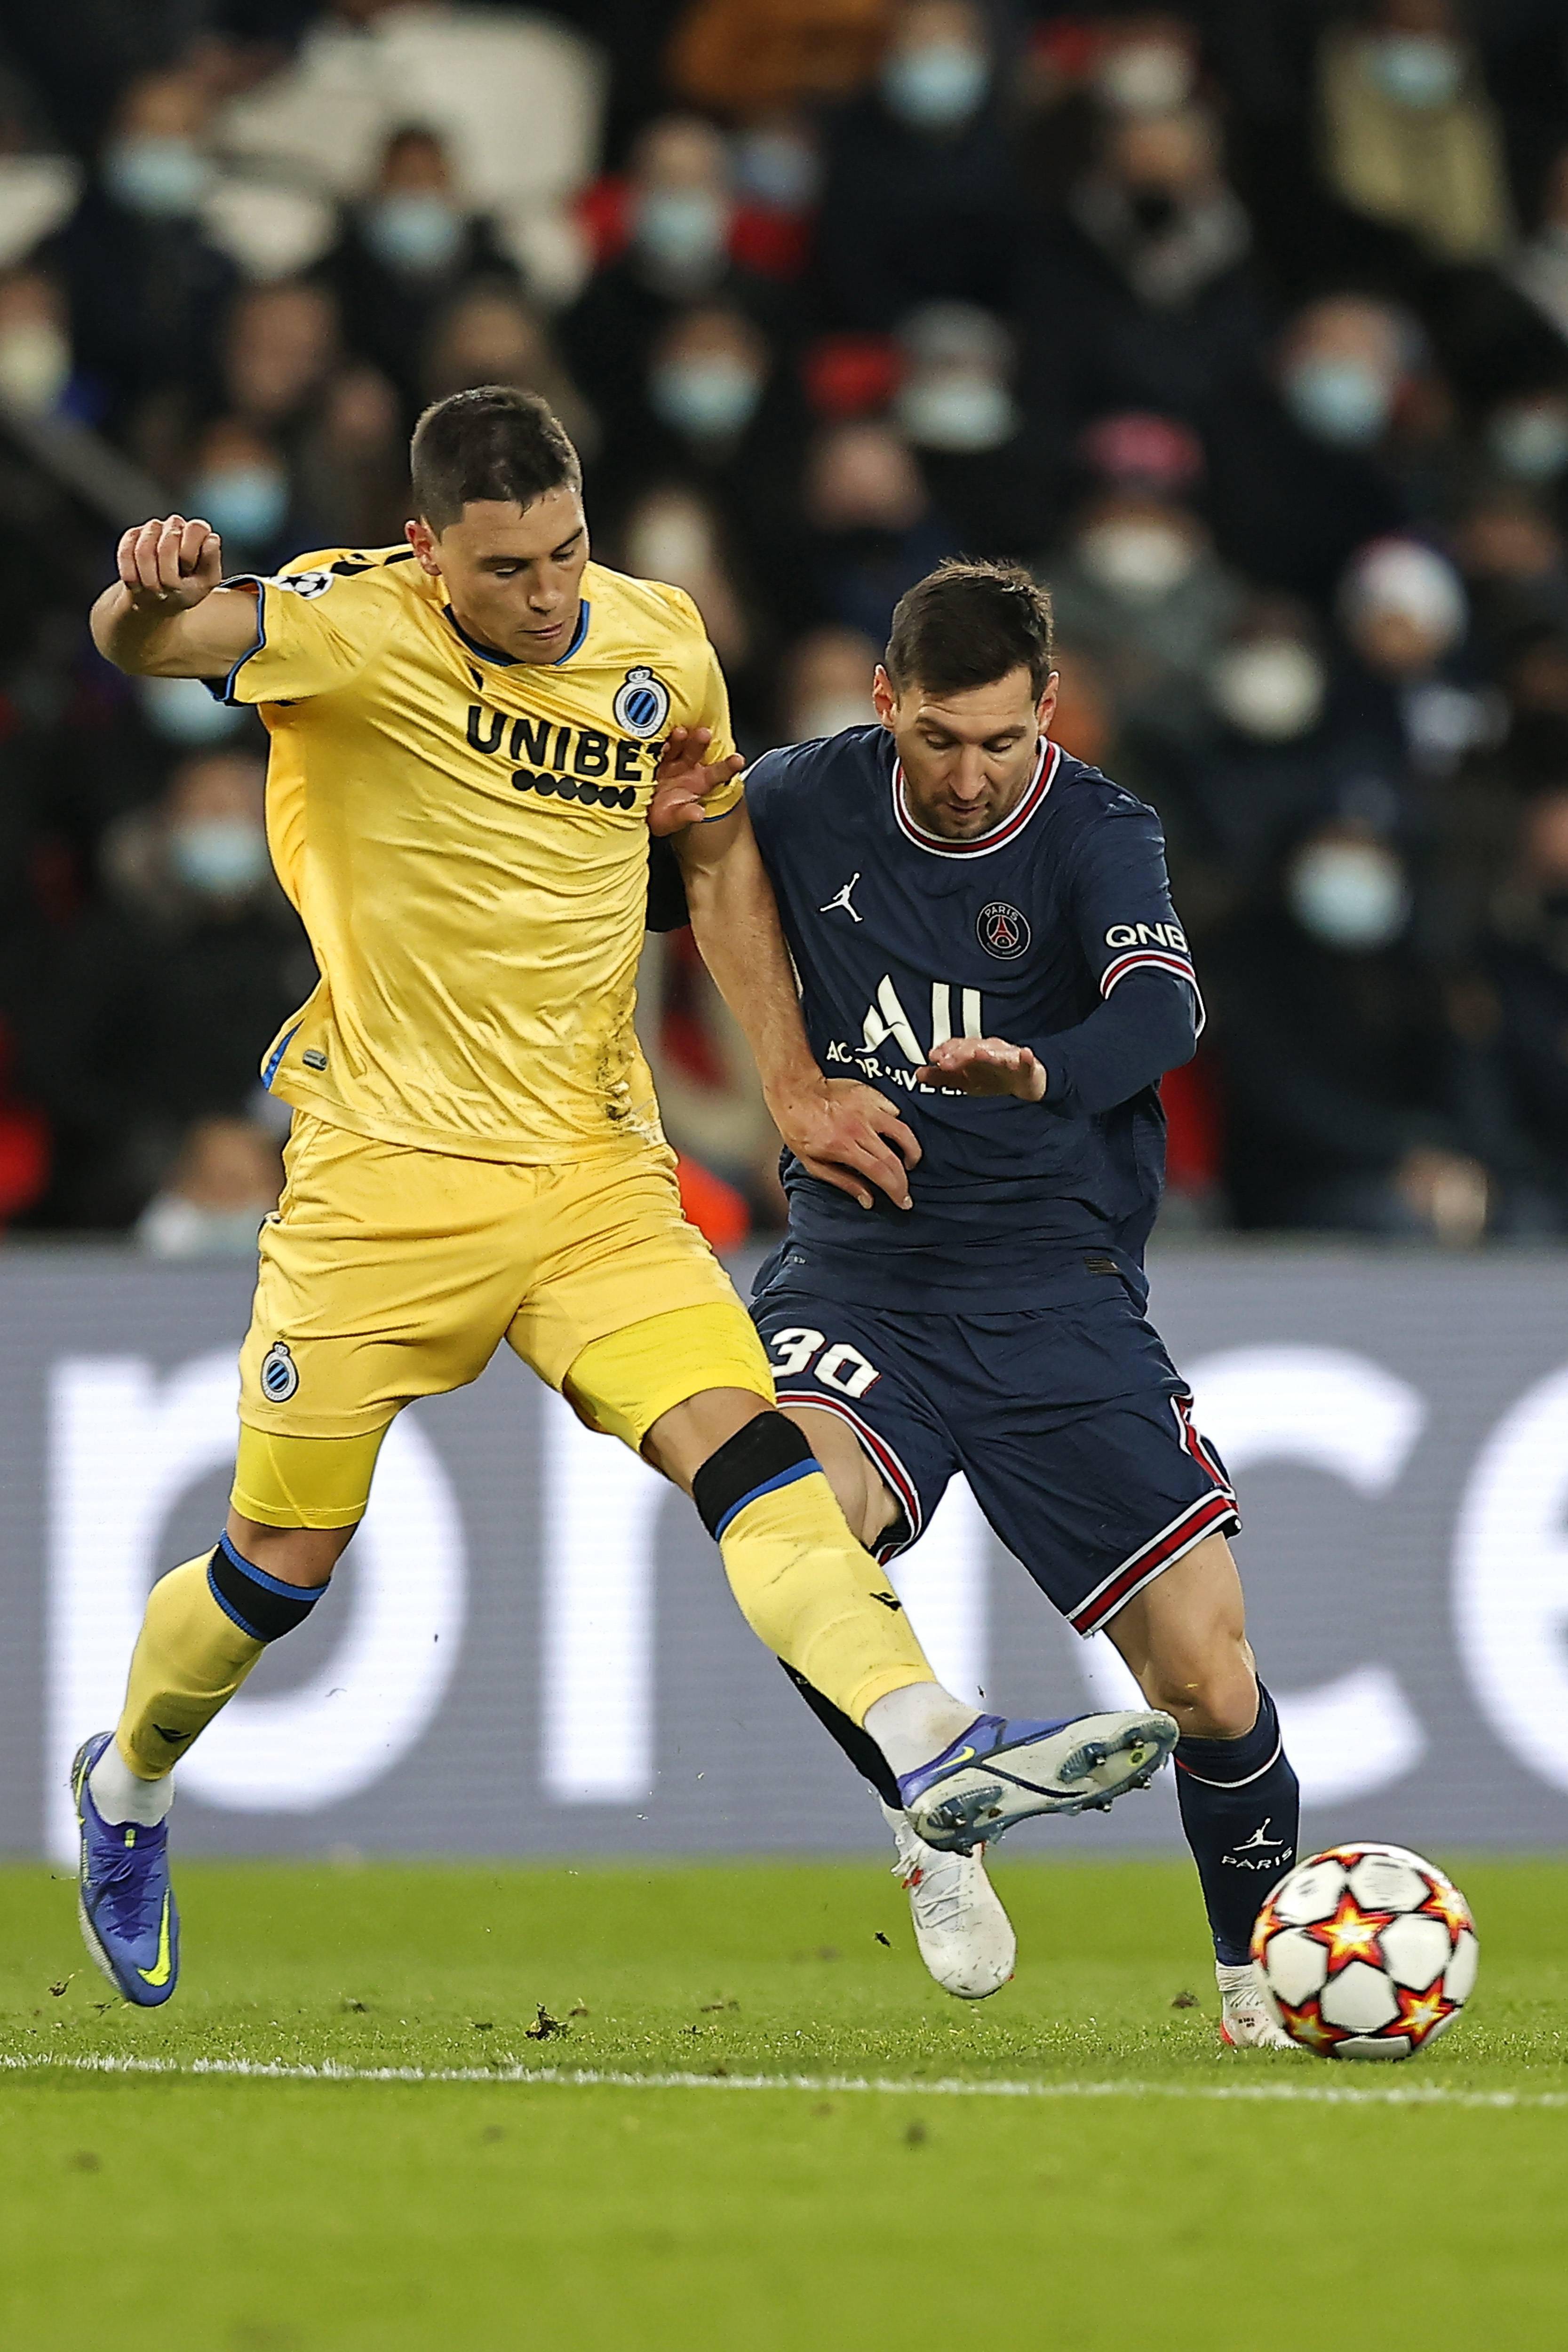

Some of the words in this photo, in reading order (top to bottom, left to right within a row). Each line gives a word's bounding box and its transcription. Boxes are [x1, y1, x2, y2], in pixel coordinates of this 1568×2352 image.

[985, 906, 1019, 921] PARIS
[1106, 923, 1188, 954] QNB
[770, 1327, 883, 1400] 30
[1222, 1846, 1293, 1870] PARIS
